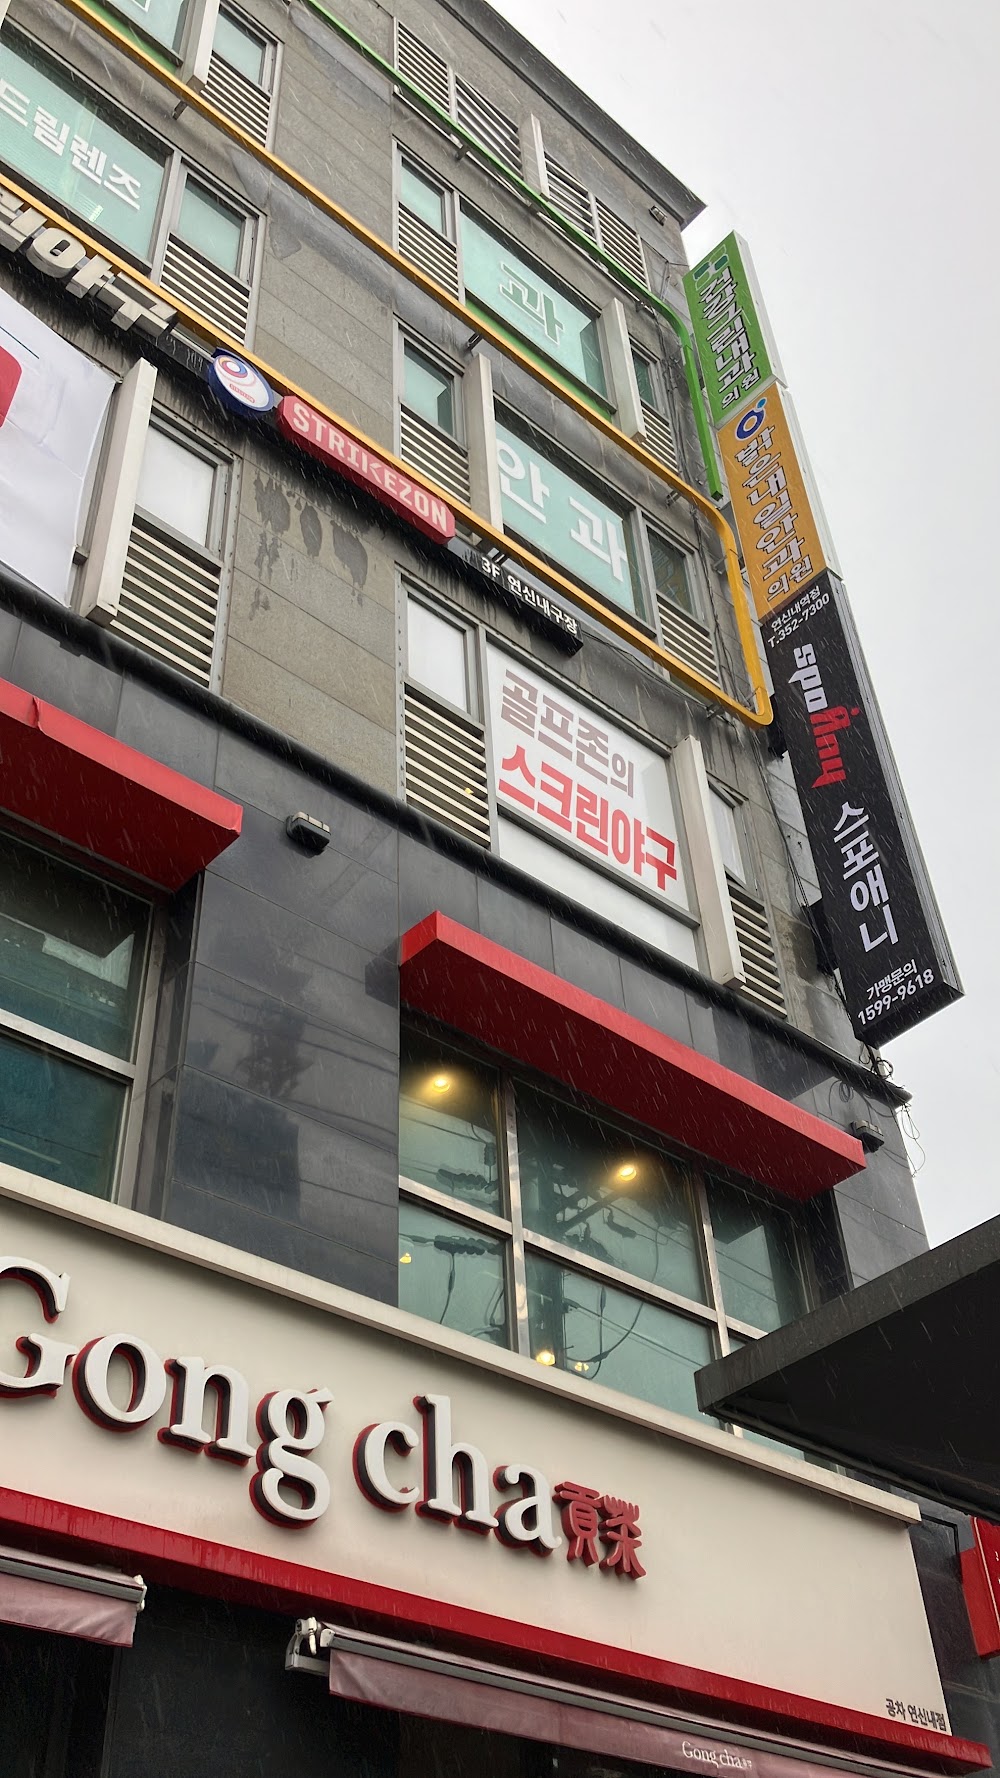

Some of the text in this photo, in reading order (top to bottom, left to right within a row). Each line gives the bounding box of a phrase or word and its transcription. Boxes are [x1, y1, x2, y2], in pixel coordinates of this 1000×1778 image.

[0, 79, 141, 210] 드림렌즈
[292, 402, 448, 532] STRIKEZON
[481, 556, 578, 635] 3F 연신내구장
[767, 592, 831, 649] T.352-7300
[770, 585, 821, 633] 연신내역점
[501, 668, 634, 799] 골프존의
[498, 744, 677, 892] 스크린야구
[833, 801, 899, 953] 스포애니
[857, 967, 935, 1026] 1599-9618
[866, 959, 918, 1001] 가맹문의
[0, 1256, 335, 1526] Gong
[352, 1394, 562, 1556] cha
[682, 1740, 719, 1769] Gong
[719, 1748, 743, 1769] cha
[885, 1698, 947, 1732] 공차 연신내점
